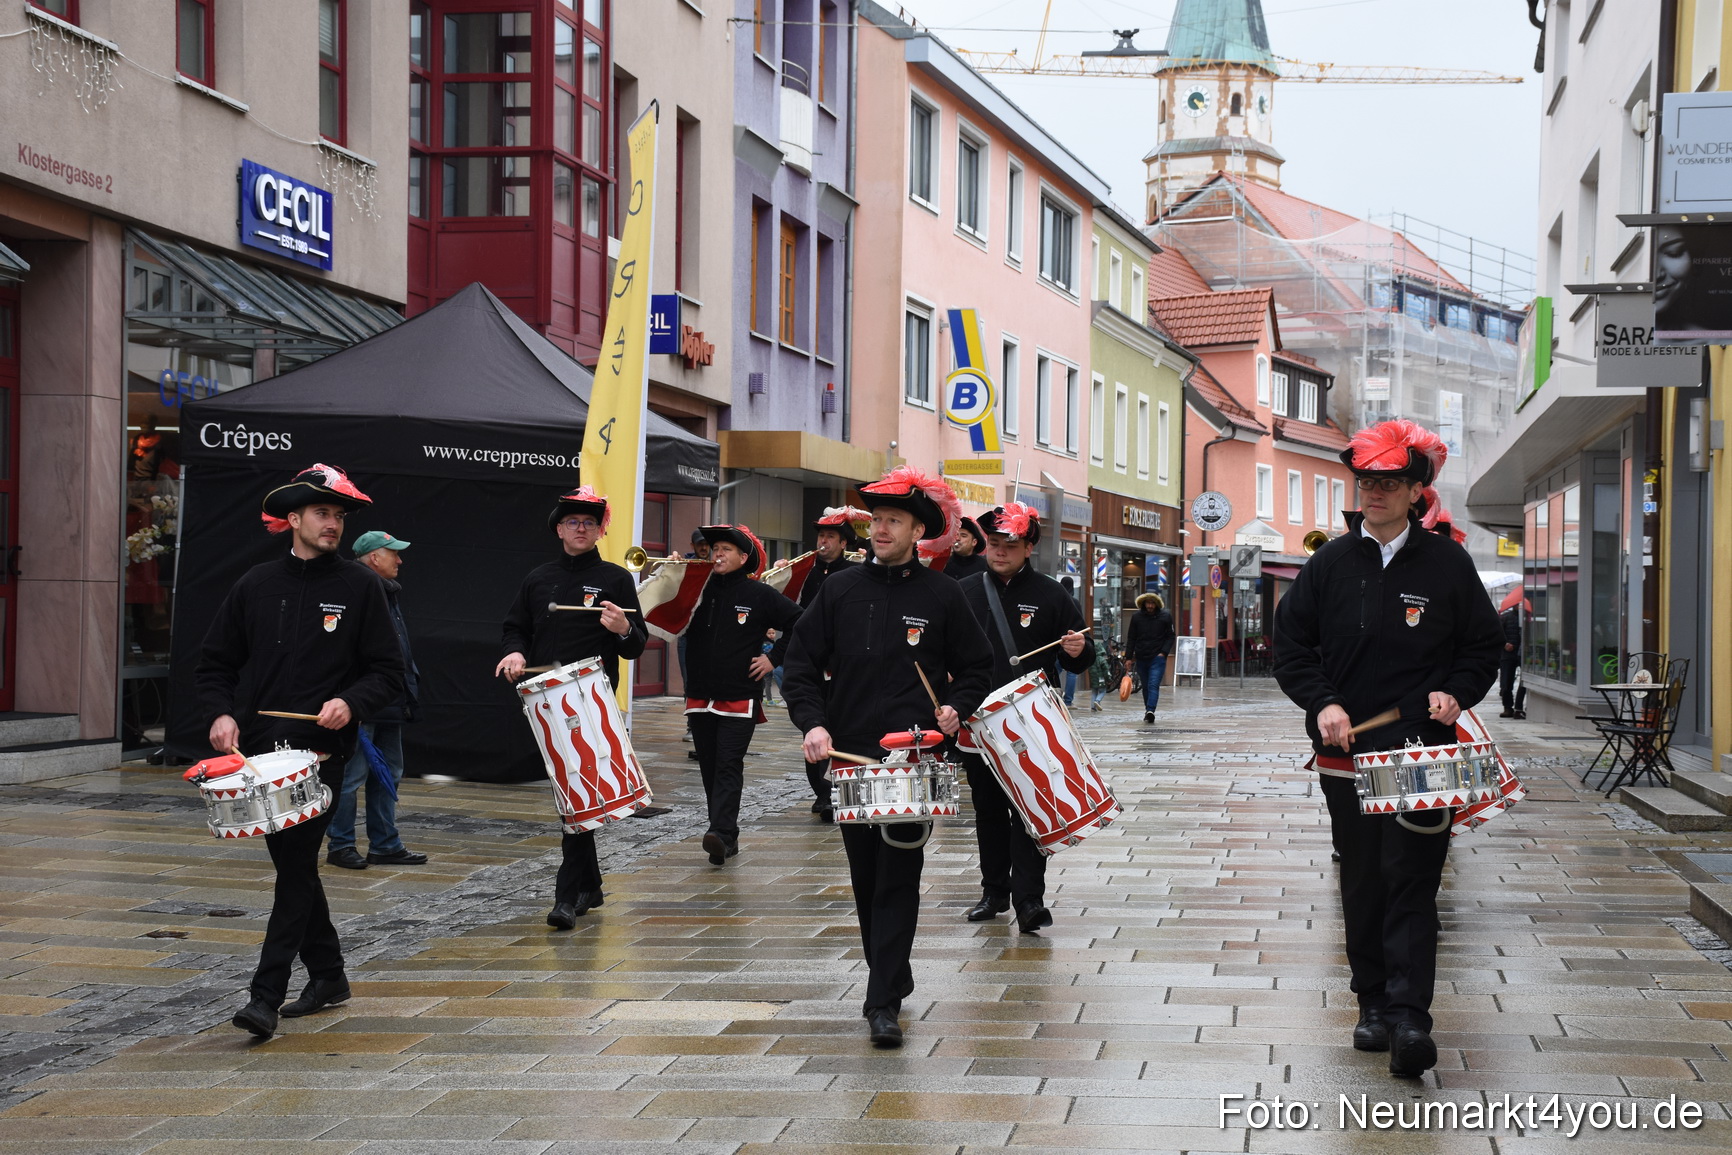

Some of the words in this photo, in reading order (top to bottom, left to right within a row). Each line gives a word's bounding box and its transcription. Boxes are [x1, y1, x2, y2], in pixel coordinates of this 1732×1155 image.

[18, 143, 102, 190] Klostergasse
[105, 174, 113, 194] 2
[1677, 157, 1723, 165] COSMETICS
[255, 173, 330, 241] CECIL
[1602, 347, 1631, 356] MODE
[1634, 347, 1641, 355] &
[1644, 346, 1697, 356] LIFESTYLE
[951, 382, 978, 410] B
[200, 422, 292, 457] Crêpes
[423, 445, 580, 468] www.creppresso.d
